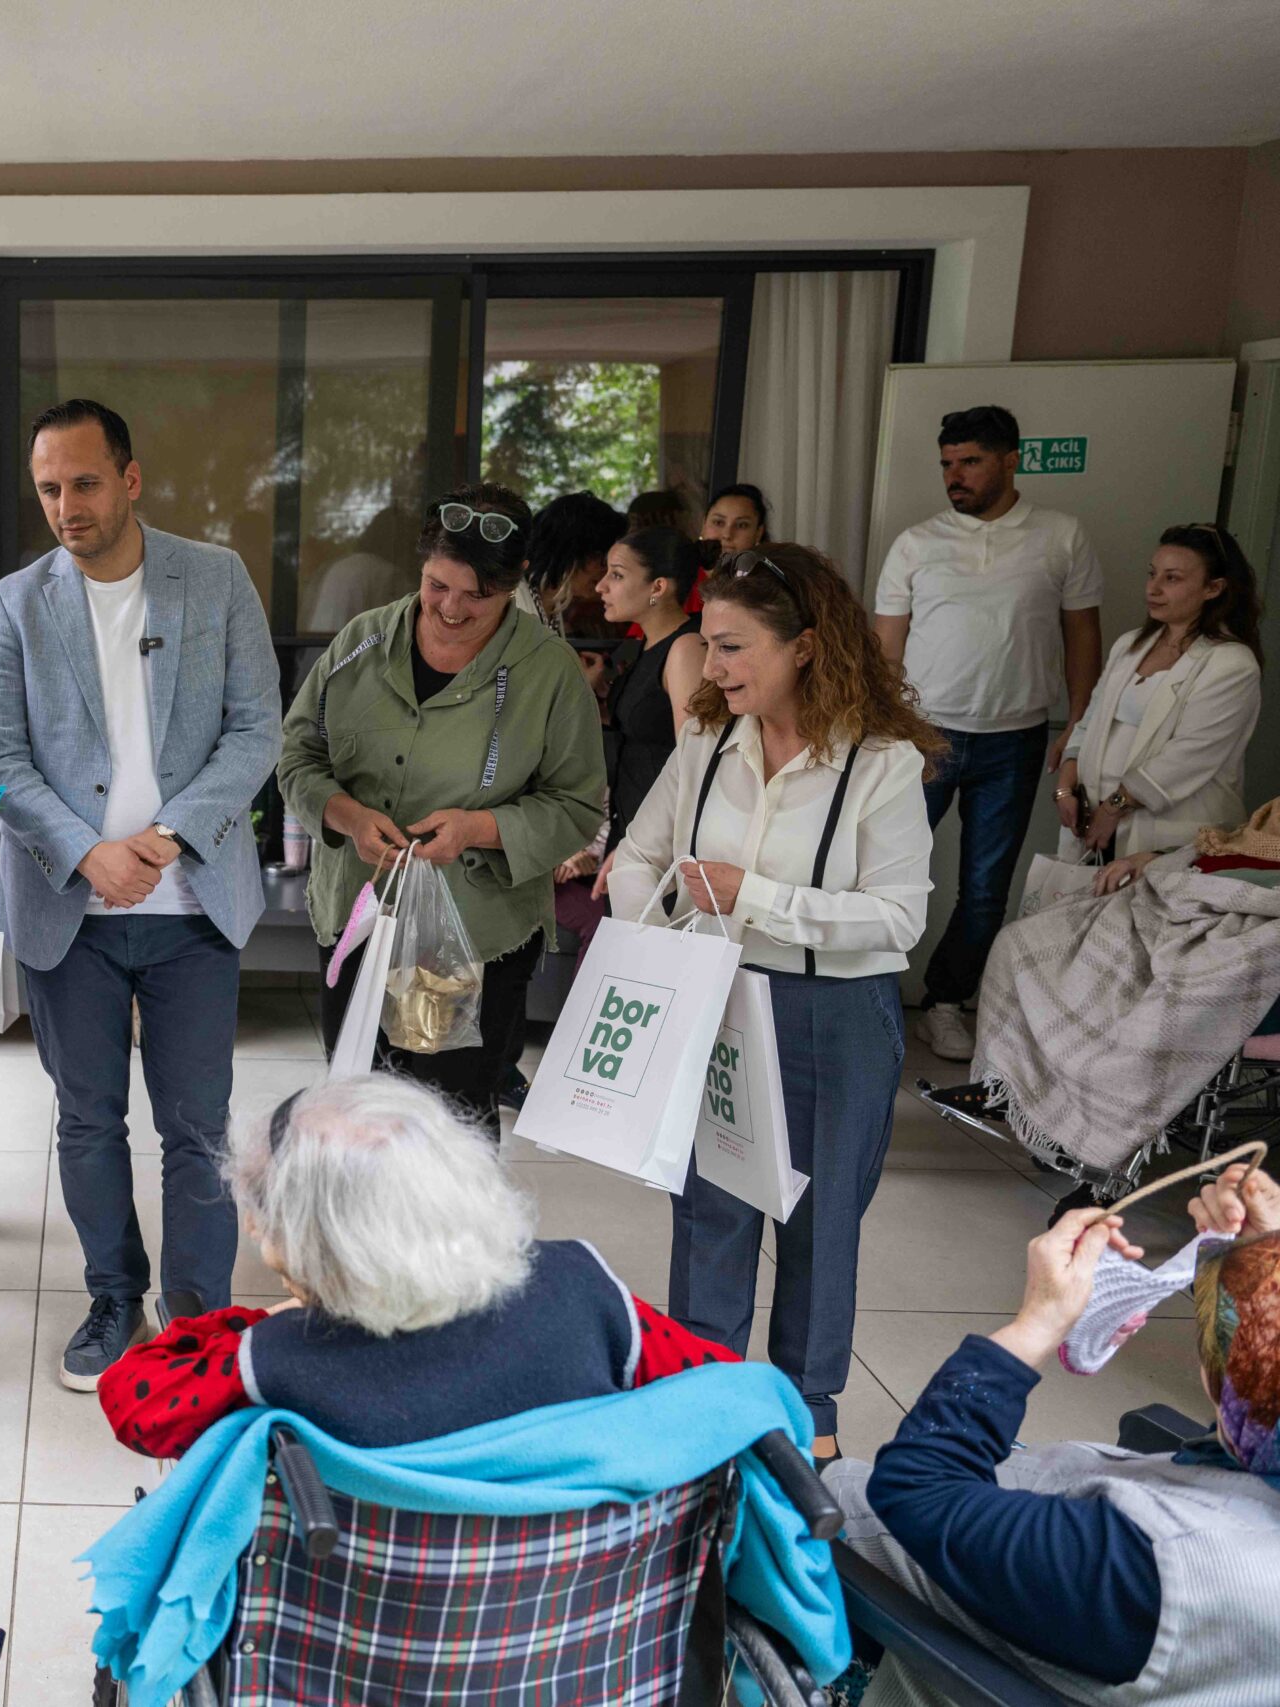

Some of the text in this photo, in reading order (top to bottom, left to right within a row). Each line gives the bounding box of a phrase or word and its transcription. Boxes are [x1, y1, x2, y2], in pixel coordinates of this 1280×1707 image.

[1050, 438, 1080, 453] ACİL
[1046, 456, 1081, 471] ÇIKIŞ
[600, 985, 660, 1028] bor
[589, 1021, 633, 1052] no
[582, 1047, 623, 1080] va
[707, 1064, 732, 1095] no
[707, 1090, 736, 1125] va
